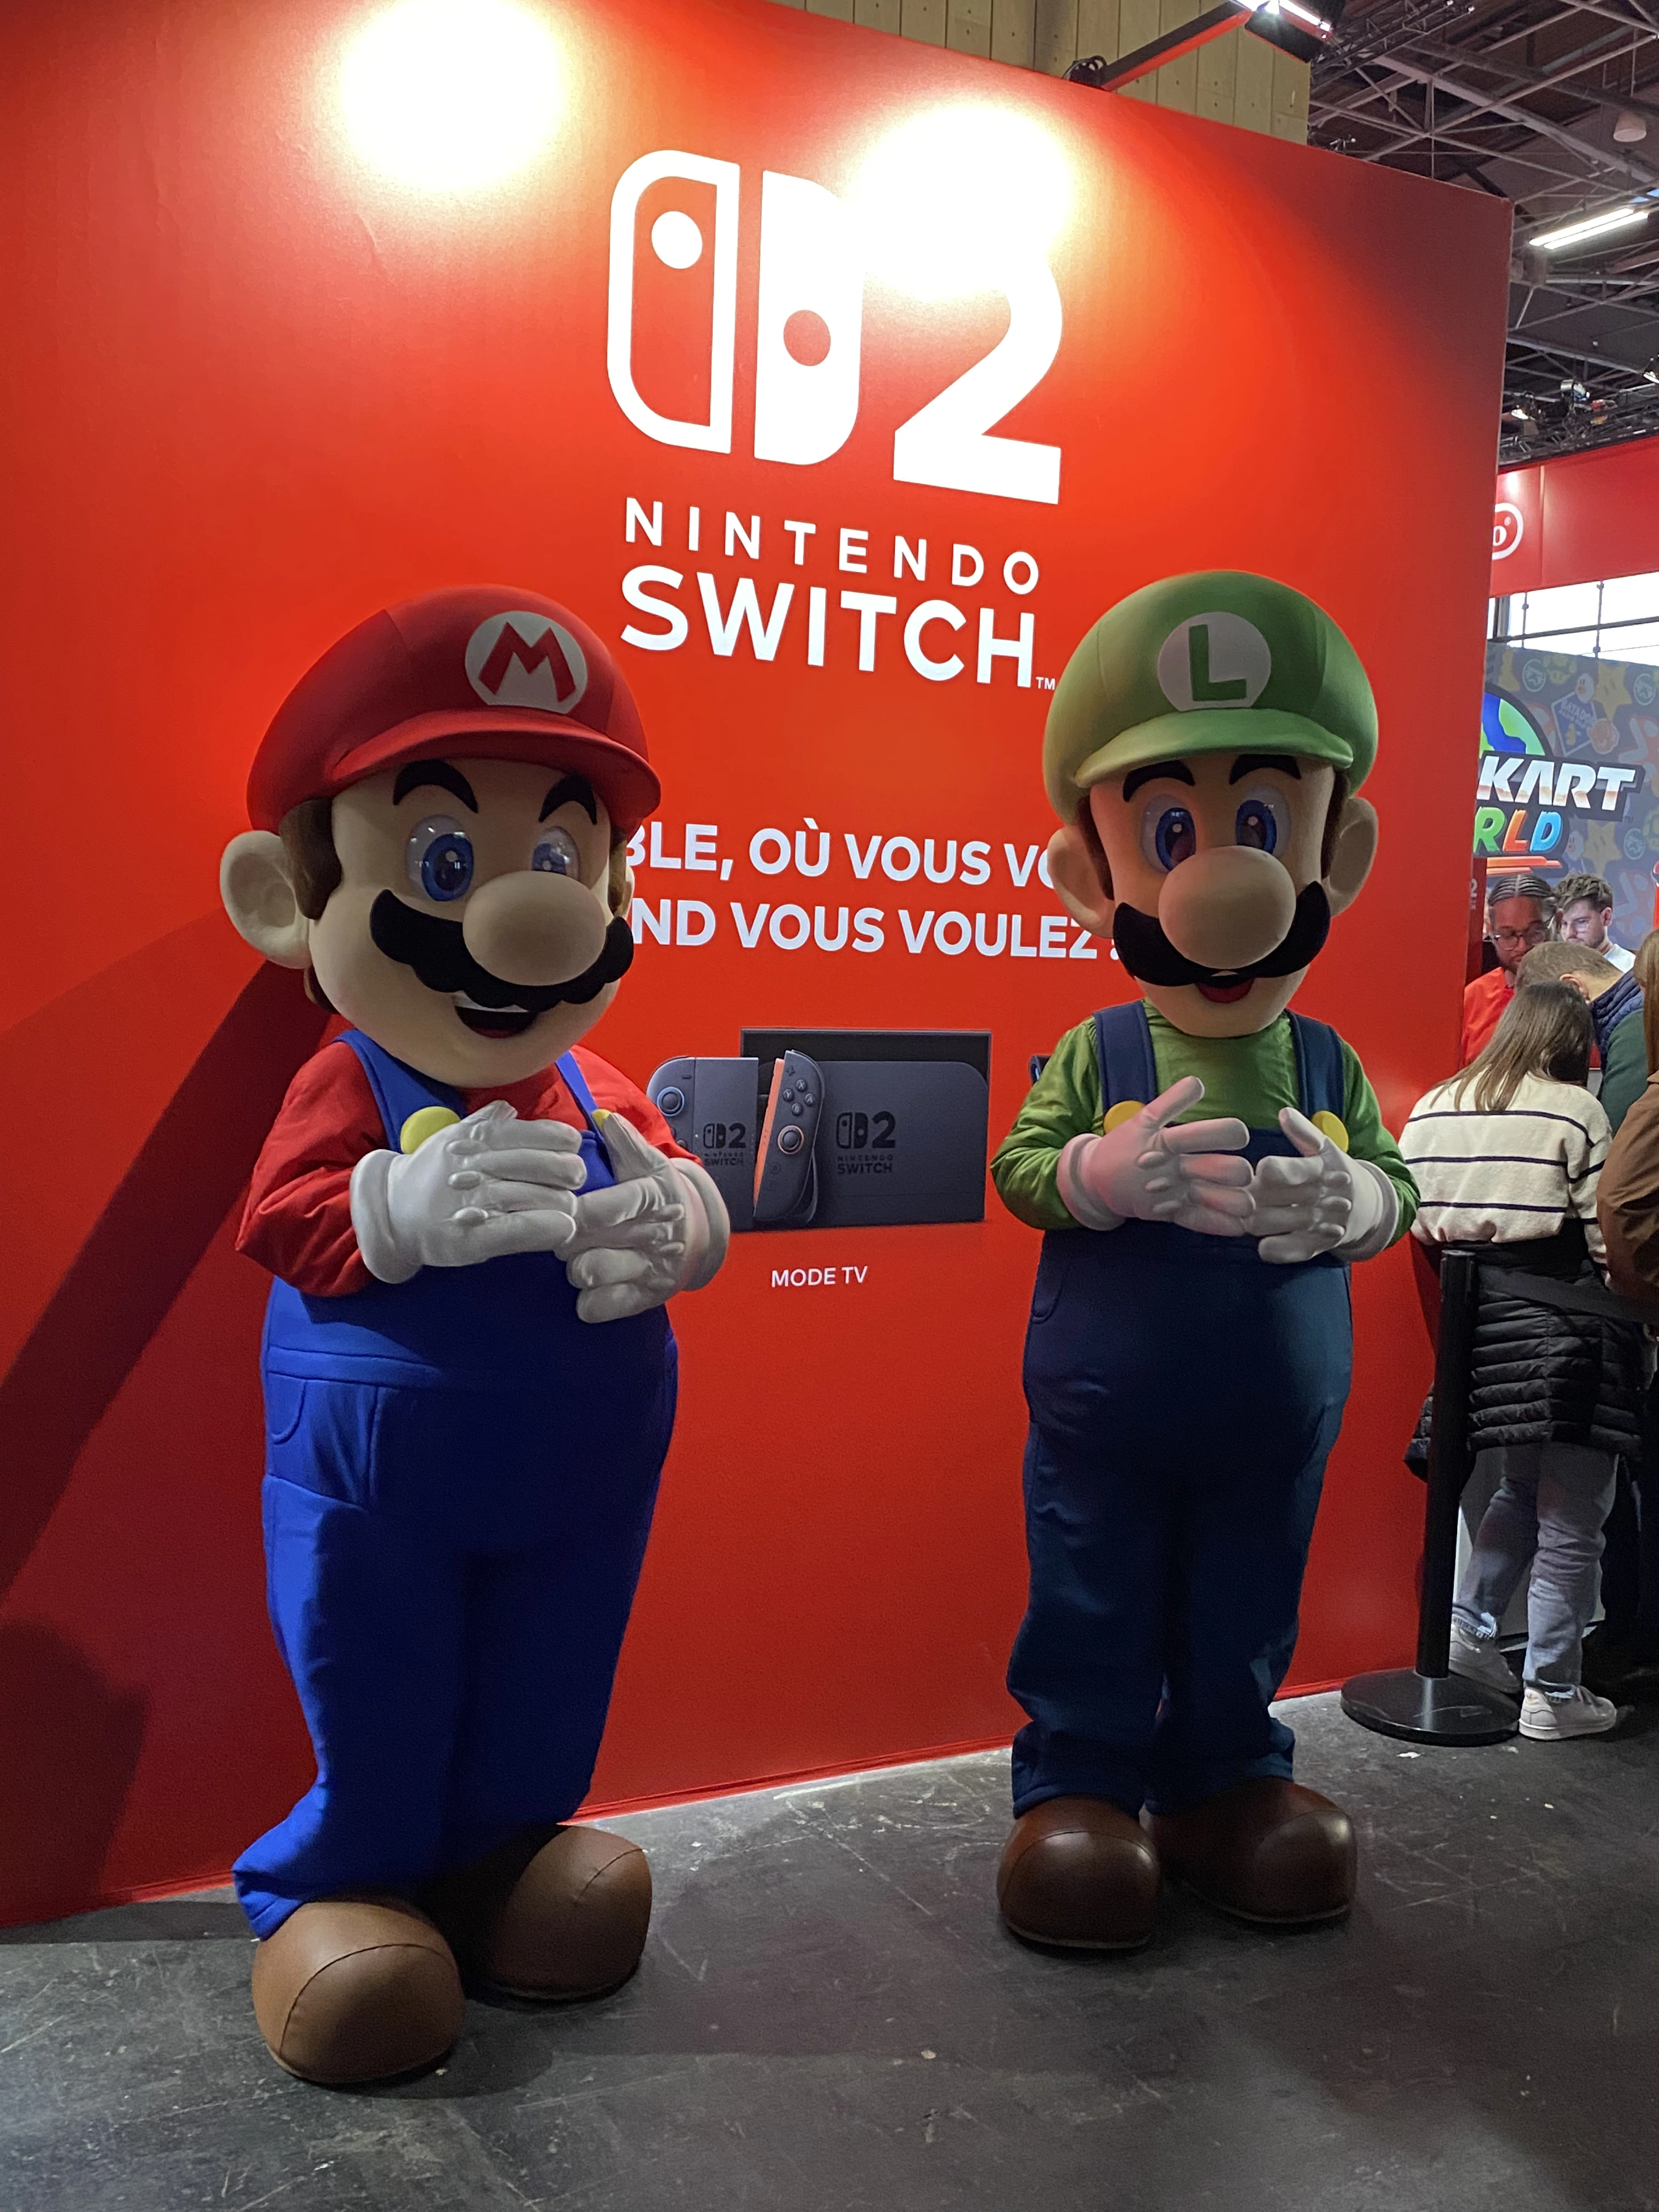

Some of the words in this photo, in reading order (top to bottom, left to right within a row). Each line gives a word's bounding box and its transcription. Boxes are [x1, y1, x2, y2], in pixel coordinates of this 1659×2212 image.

[893, 219, 1063, 505] 2
[625, 497, 1040, 595] NINTENDO
[620, 565, 1035, 689] SWITCH
[479, 622, 576, 703] M
[1189, 624, 1247, 702] L
[1476, 755, 1636, 811] KART
[749, 817, 831, 877] OÙ
[844, 833, 991, 885] VOUS
[1473, 806, 1564, 854] RLD
[730, 902, 884, 953] VOUS
[898, 909, 1097, 959] VOULEZ
[728, 1122, 746, 1148] 2
[872, 1111, 896, 1148] 2
[837, 1162, 893, 1175] SWITCH
[771, 1267, 836, 1288] MODE
[842, 1266, 868, 1284] TV
